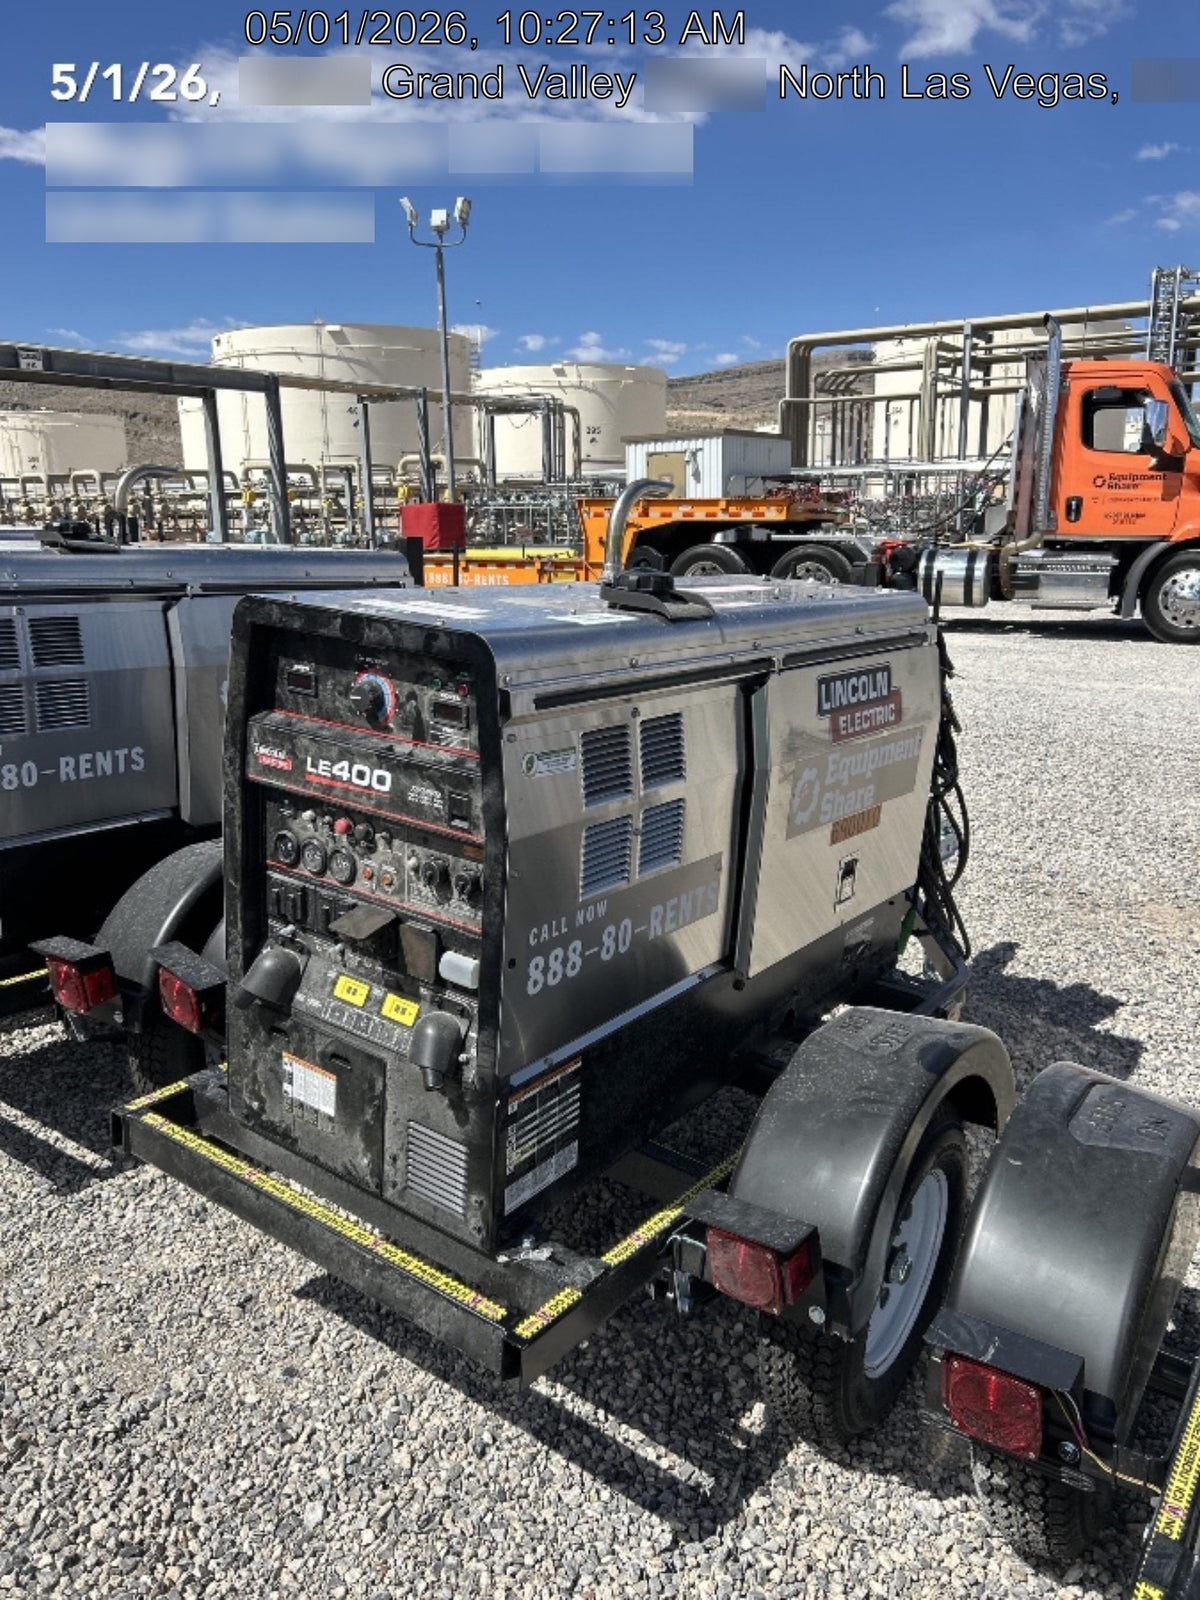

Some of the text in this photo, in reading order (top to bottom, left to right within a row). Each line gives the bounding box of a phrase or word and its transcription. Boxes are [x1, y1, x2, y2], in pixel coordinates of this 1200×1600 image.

[1108, 472, 1168, 482] Equipment
[820, 671, 890, 711] LINCOLN
[838, 703, 896, 736] ELECTRIC
[306, 756, 392, 792] LE400
[824, 732, 922, 785] Equipment
[820, 783, 876, 825] Share
[526, 879, 718, 997] 888-80-RENTS
[528, 899, 608, 946] CALL NOW
[1179, 1442, 1199, 1487] DEBOUT
[1173, 1486, 1186, 1502] ICI
